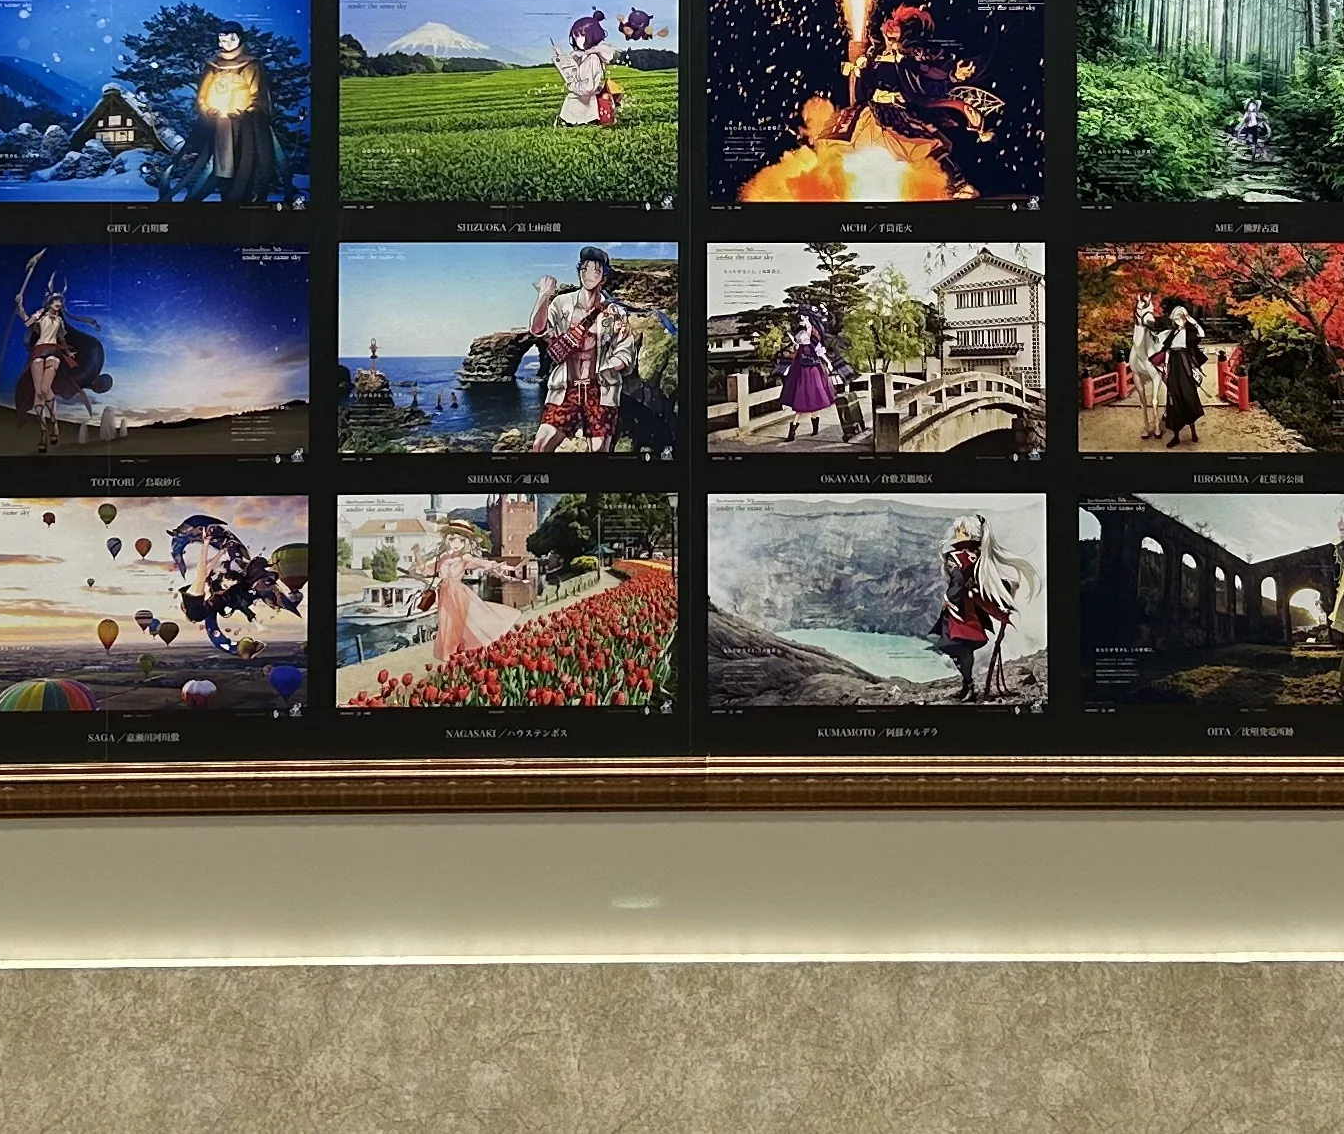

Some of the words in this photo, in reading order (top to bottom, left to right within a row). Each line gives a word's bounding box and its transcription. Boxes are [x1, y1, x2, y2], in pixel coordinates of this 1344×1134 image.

[106, 223, 131, 233] GIFU
[457, 223, 507, 232] SHIZUOKA
[840, 223, 867, 232] AICHI
[1214, 223, 1234, 233] MIE
[90, 477, 135, 487] TOTTORI
[467, 474, 513, 484] SHIMANE
[820, 474, 871, 483] OKAYAMA
[1193, 474, 1250, 484] HIROSHIMA
[445, 729, 497, 739] NAGASAKI
[817, 727, 876, 738] KUMAMOTO
[1206, 727, 1232, 736] OITA
[87, 733, 116, 743] SAGA
